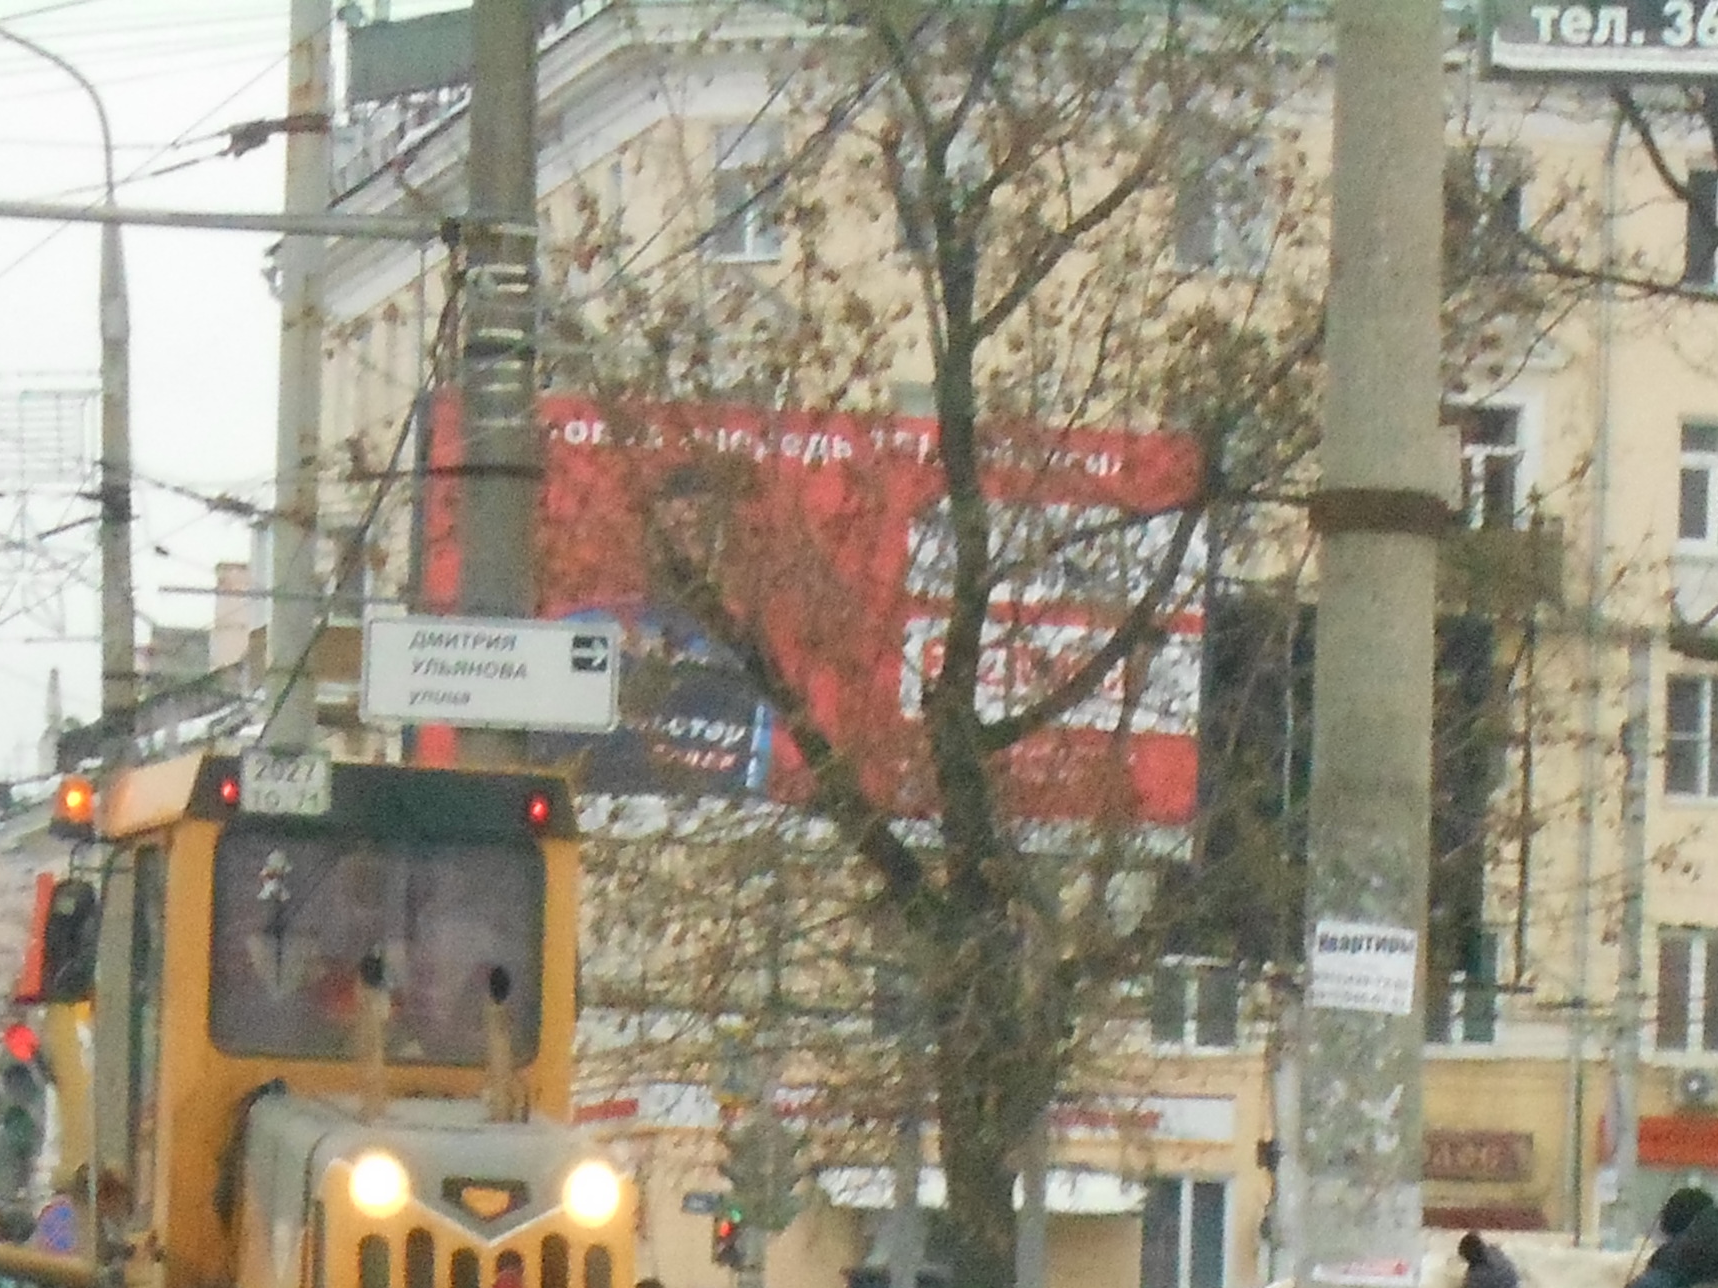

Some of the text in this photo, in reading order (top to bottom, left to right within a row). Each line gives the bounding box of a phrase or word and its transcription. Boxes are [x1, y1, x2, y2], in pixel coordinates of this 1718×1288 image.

[1531, 4, 1646, 45] тел.
[408, 630, 518, 651] ДМИТРИЯ
[410, 656, 527, 680] УЛЬЯНОВА
